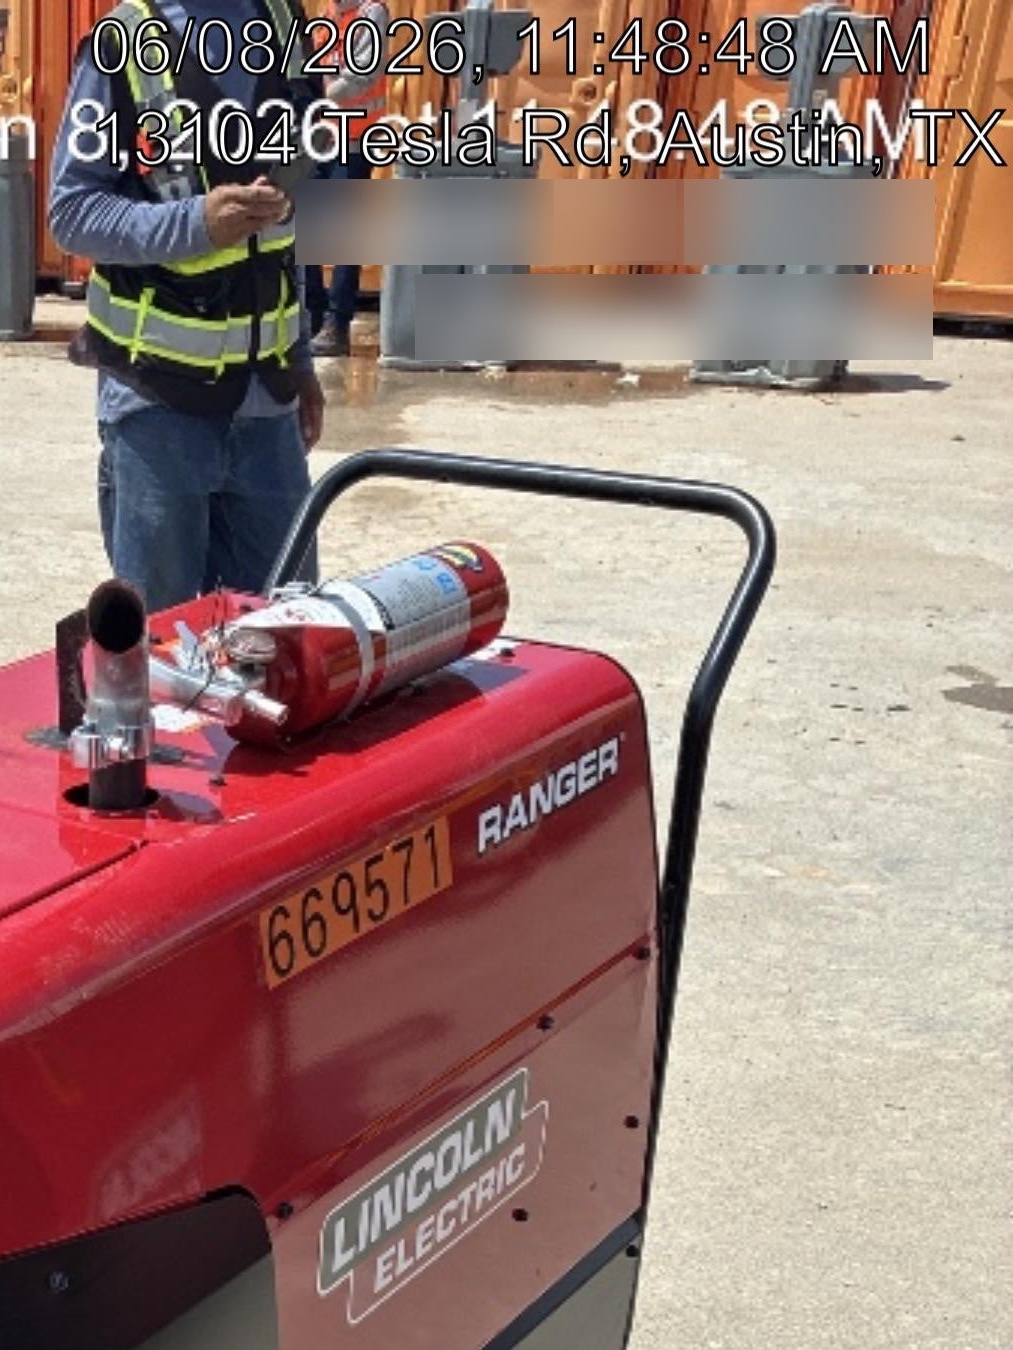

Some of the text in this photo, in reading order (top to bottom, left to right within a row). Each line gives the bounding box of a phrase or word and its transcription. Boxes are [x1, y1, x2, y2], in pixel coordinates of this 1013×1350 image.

[477, 737, 619, 854] RANGER
[267, 824, 441, 978] 669571
[331, 1087, 517, 1274] LINCOLN
[373, 1142, 526, 1295] ELECTRIC
